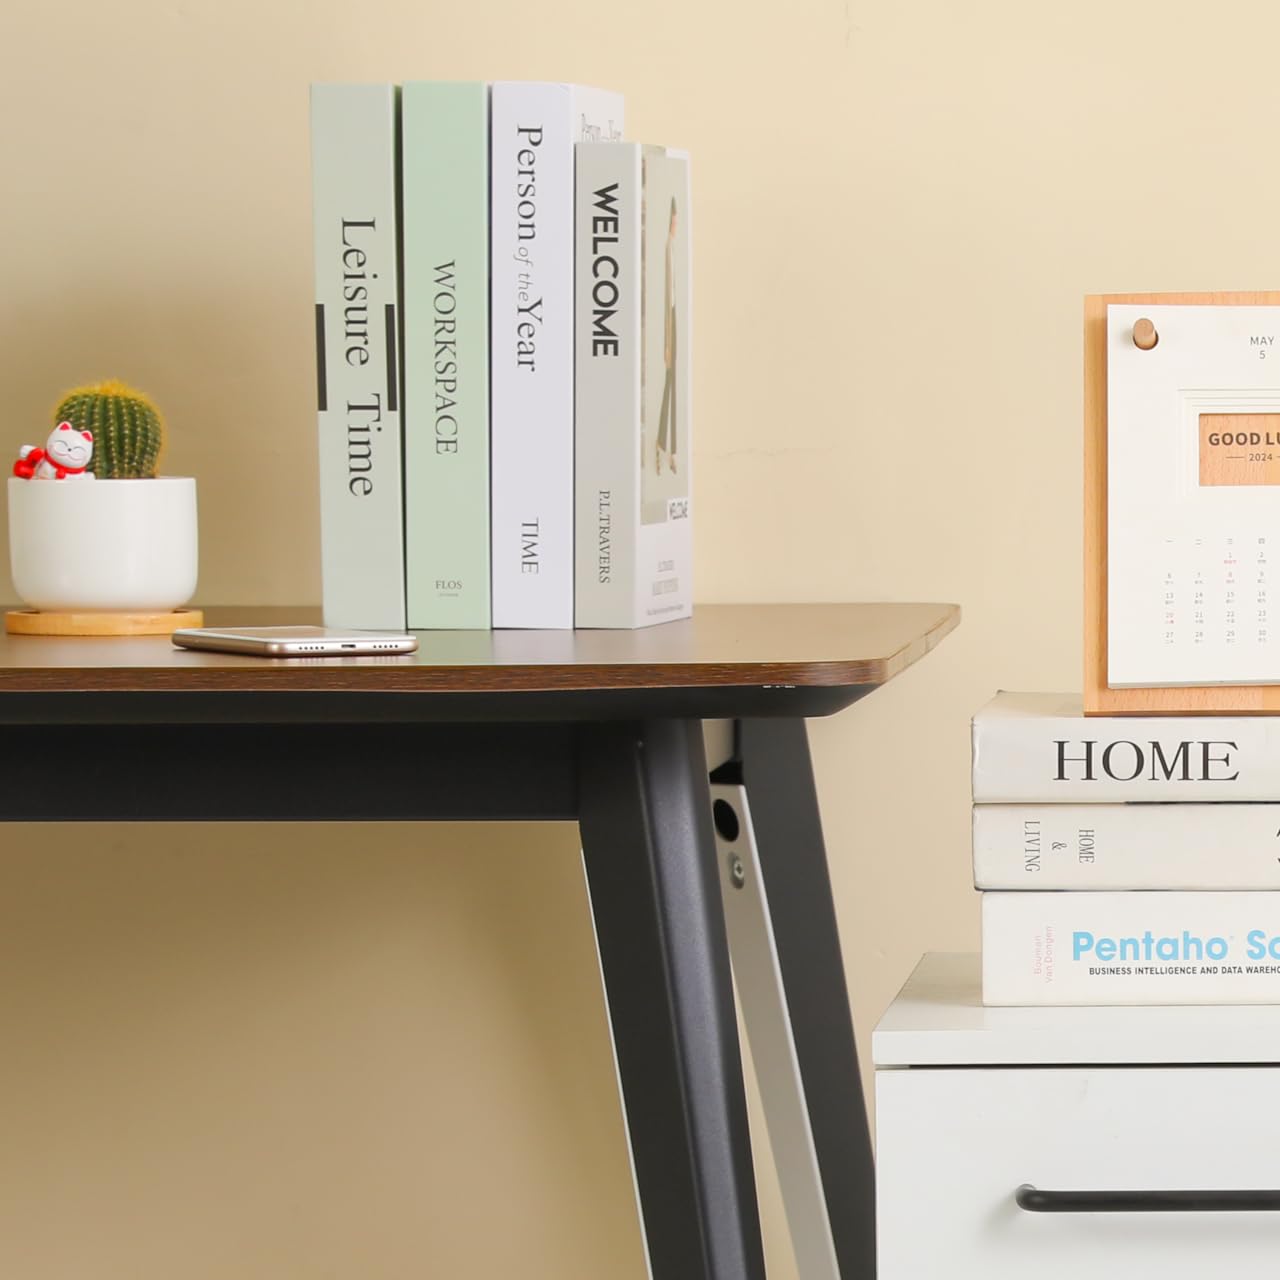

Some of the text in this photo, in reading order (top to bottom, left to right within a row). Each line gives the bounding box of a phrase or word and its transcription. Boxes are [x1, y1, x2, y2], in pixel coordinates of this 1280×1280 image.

[513, 125, 543, 373] Person of the Year
[591, 182, 620, 358] WELCOME
[341, 217, 383, 497] Leisure Time
[433, 259, 458, 455] WORKSPACE
[1249, 335, 1275, 346] MAY
[1259, 349, 1266, 360] 5
[1208, 431, 1261, 447] GOOD
[1248, 452, 1273, 462] 2024
[521, 517, 540, 574] TIME
[434, 579, 464, 590] FLOS
[1052, 740, 1240, 782] HOME
[1024, 820, 1041, 873] LIVING
[1051, 841, 1068, 851] &
[1078, 829, 1095, 864] HOME
[1071, 930, 1229, 962] Pentaho
[1088, 966, 1133, 976] BUSINESS
[1134, 966, 1198, 976] INTELLIGENCE
[1199, 966, 1219, 975] AND
[1220, 965, 1244, 975] DATA
